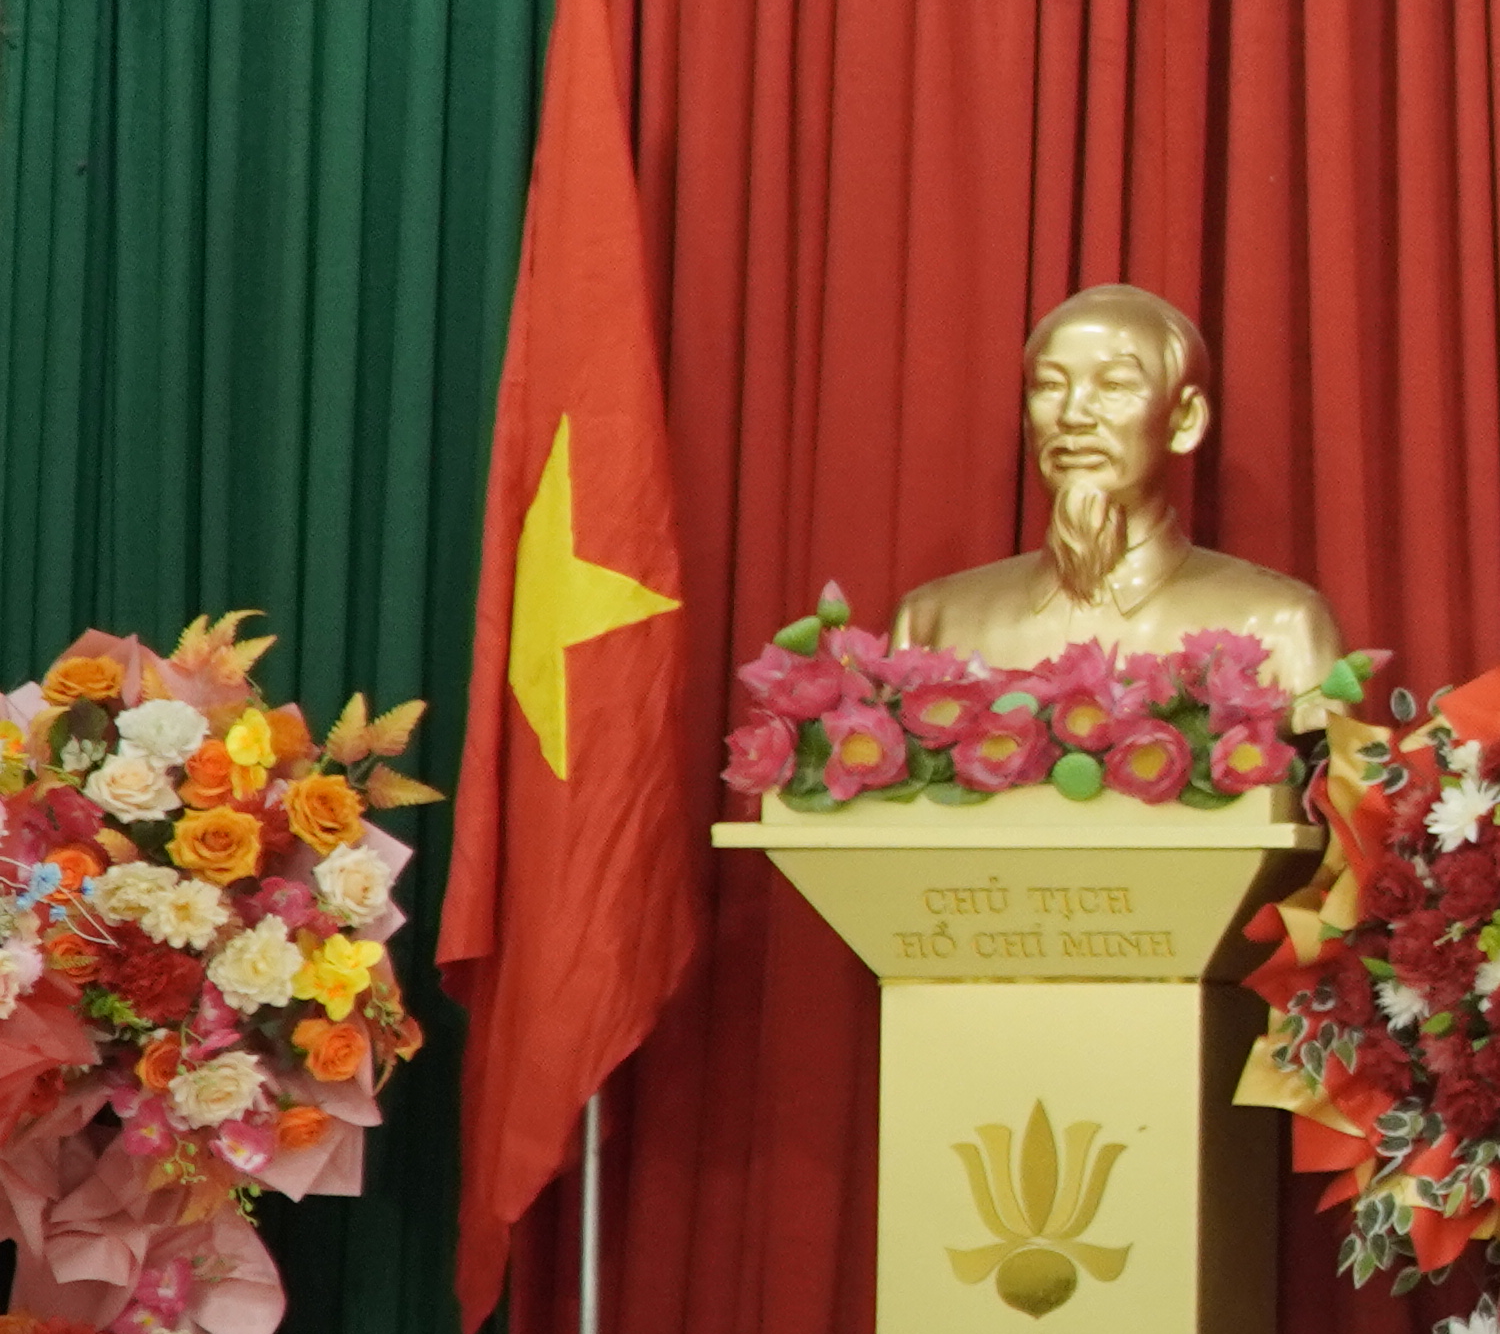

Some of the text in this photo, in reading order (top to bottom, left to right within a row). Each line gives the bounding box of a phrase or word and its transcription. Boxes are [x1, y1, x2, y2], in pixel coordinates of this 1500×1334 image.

[922, 876, 1134, 921] CHỦ TỊCH
[971, 921, 1047, 960] CHÍ
[1059, 929, 1178, 959] MINH
